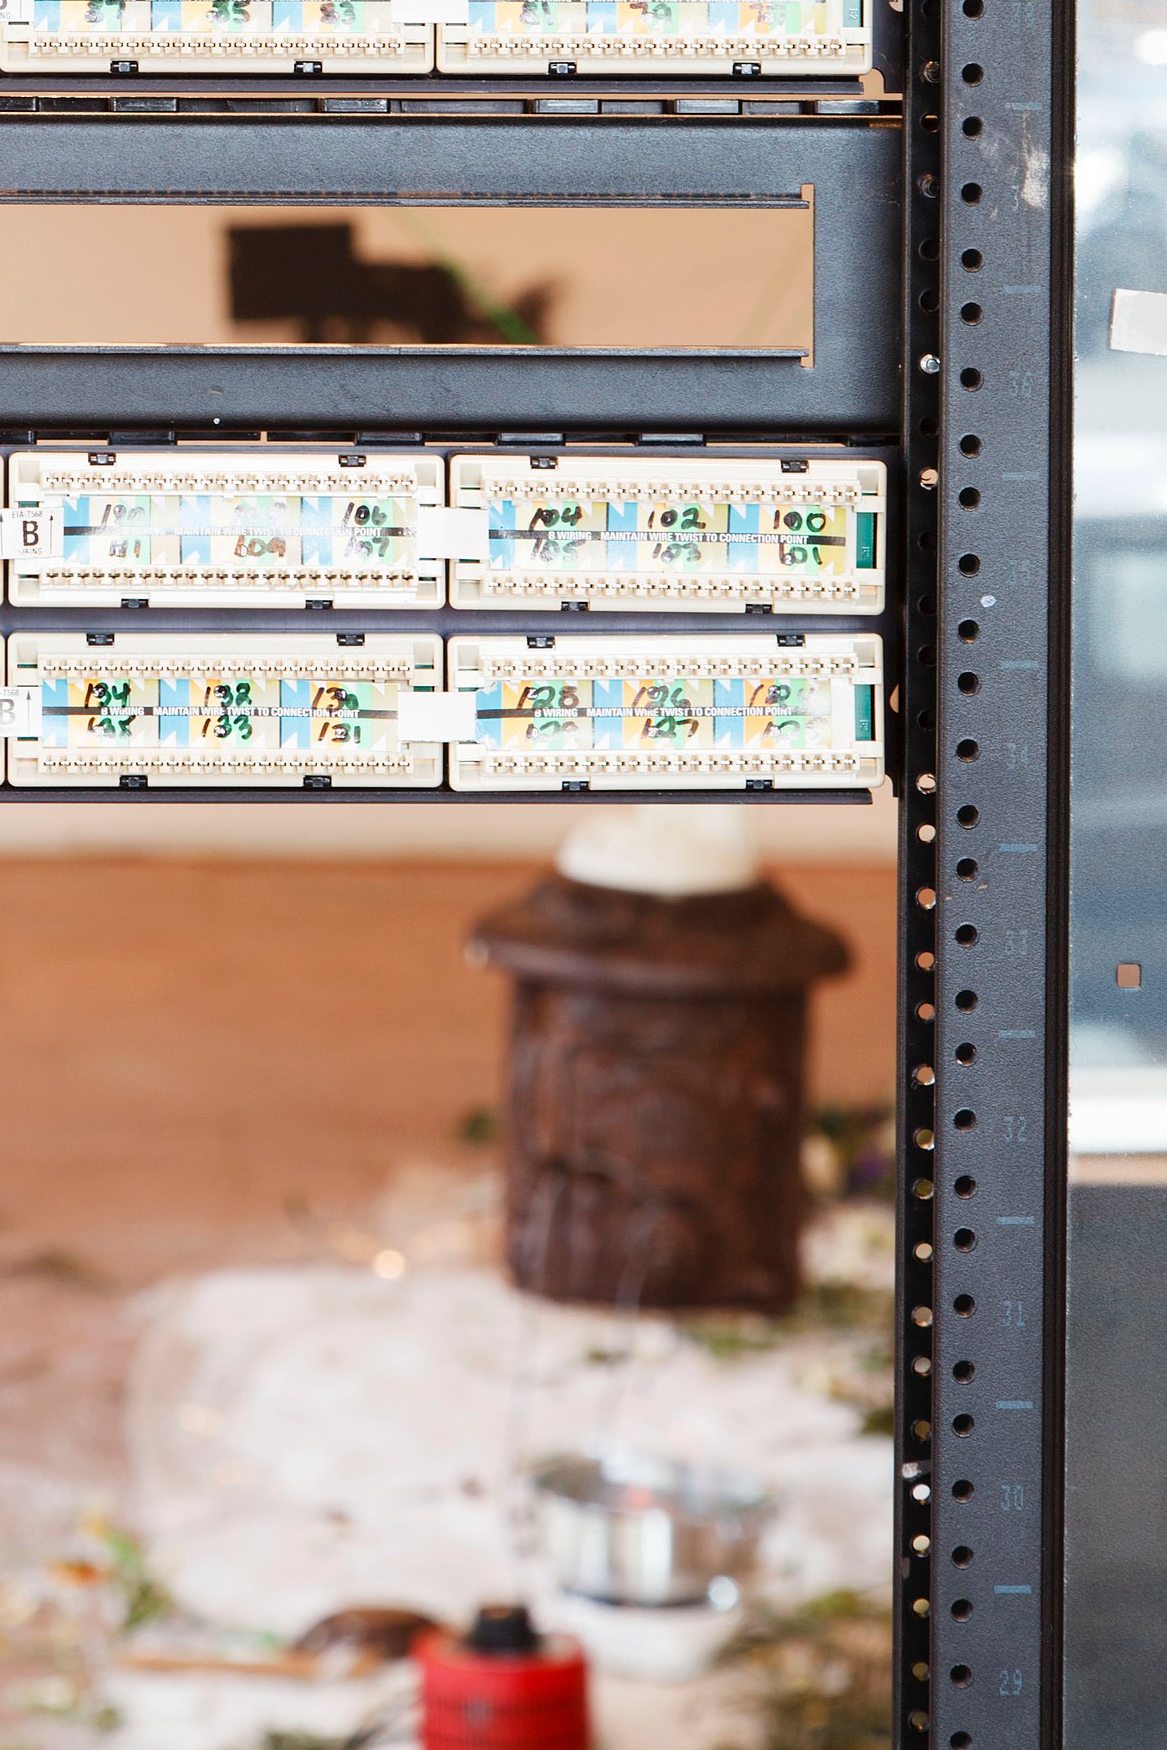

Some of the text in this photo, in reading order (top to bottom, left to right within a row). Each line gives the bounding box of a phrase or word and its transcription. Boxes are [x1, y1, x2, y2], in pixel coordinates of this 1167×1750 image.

[647, 507, 706, 529] 102
[773, 509, 826, 533] 100
[22, 520, 39, 547] B
[557, 531, 592, 540] WIRING
[600, 532, 647, 542] MAINTAIN
[648, 533, 673, 542] WIRE
[674, 533, 704, 543] TWIST
[705, 534, 718, 543] TO
[719, 534, 779, 544] CONNECTION
[780, 535, 808, 544] POINT
[84, 682, 131, 708] 134
[202, 714, 253, 740] 133
[317, 721, 361, 744] 131
